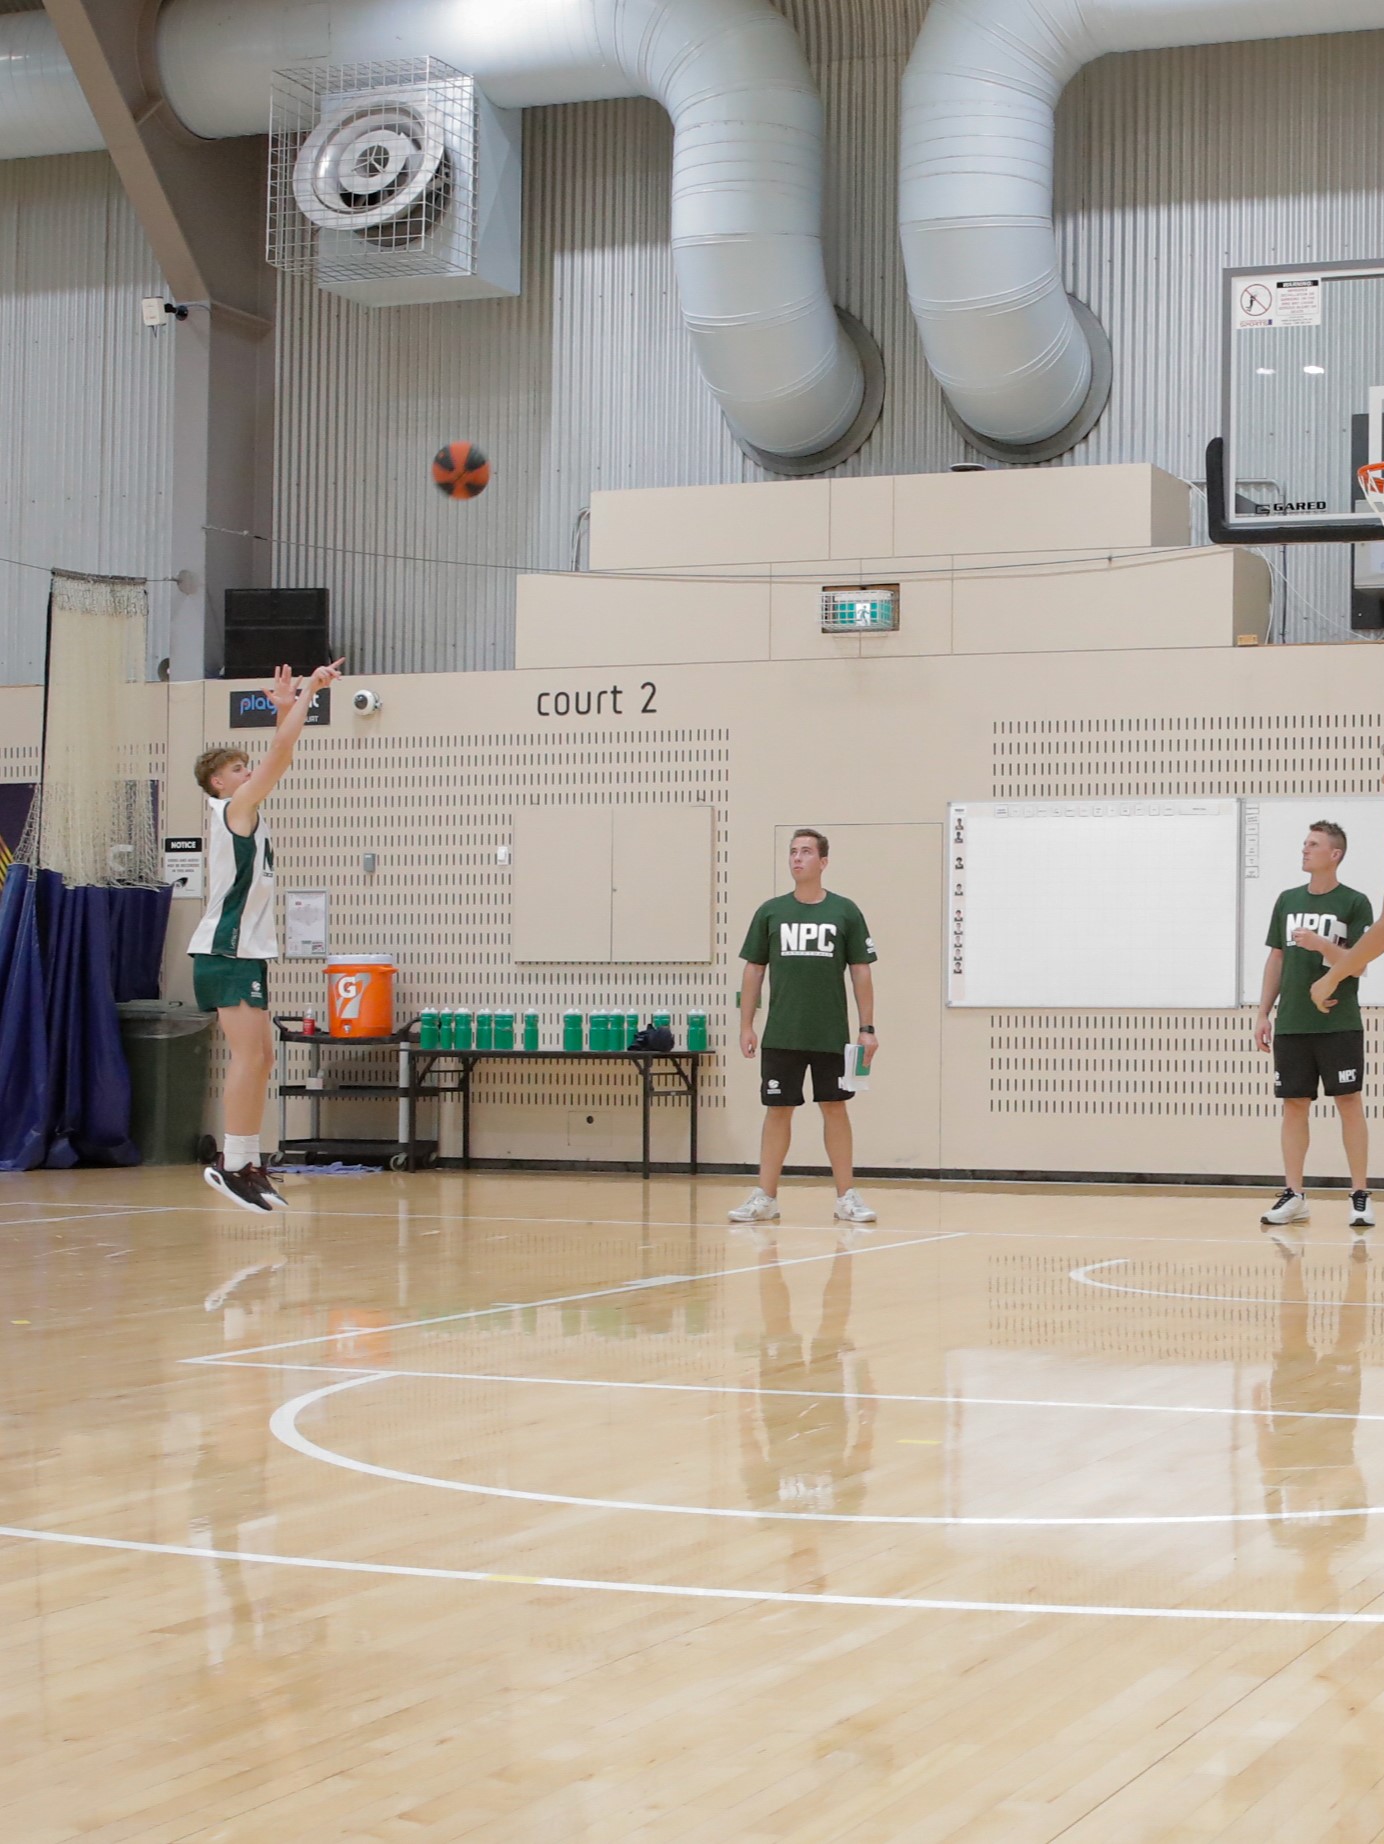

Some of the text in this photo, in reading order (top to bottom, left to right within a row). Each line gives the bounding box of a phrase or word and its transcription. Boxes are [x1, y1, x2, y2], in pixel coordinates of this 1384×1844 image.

[1273, 501, 1327, 511] GARED
[537, 681, 657, 716] court 2
[171, 841, 196, 849] NOTICE
[780, 922, 837, 953] NPC
[338, 976, 356, 998] G
[1338, 1068, 1357, 1082] NPC
